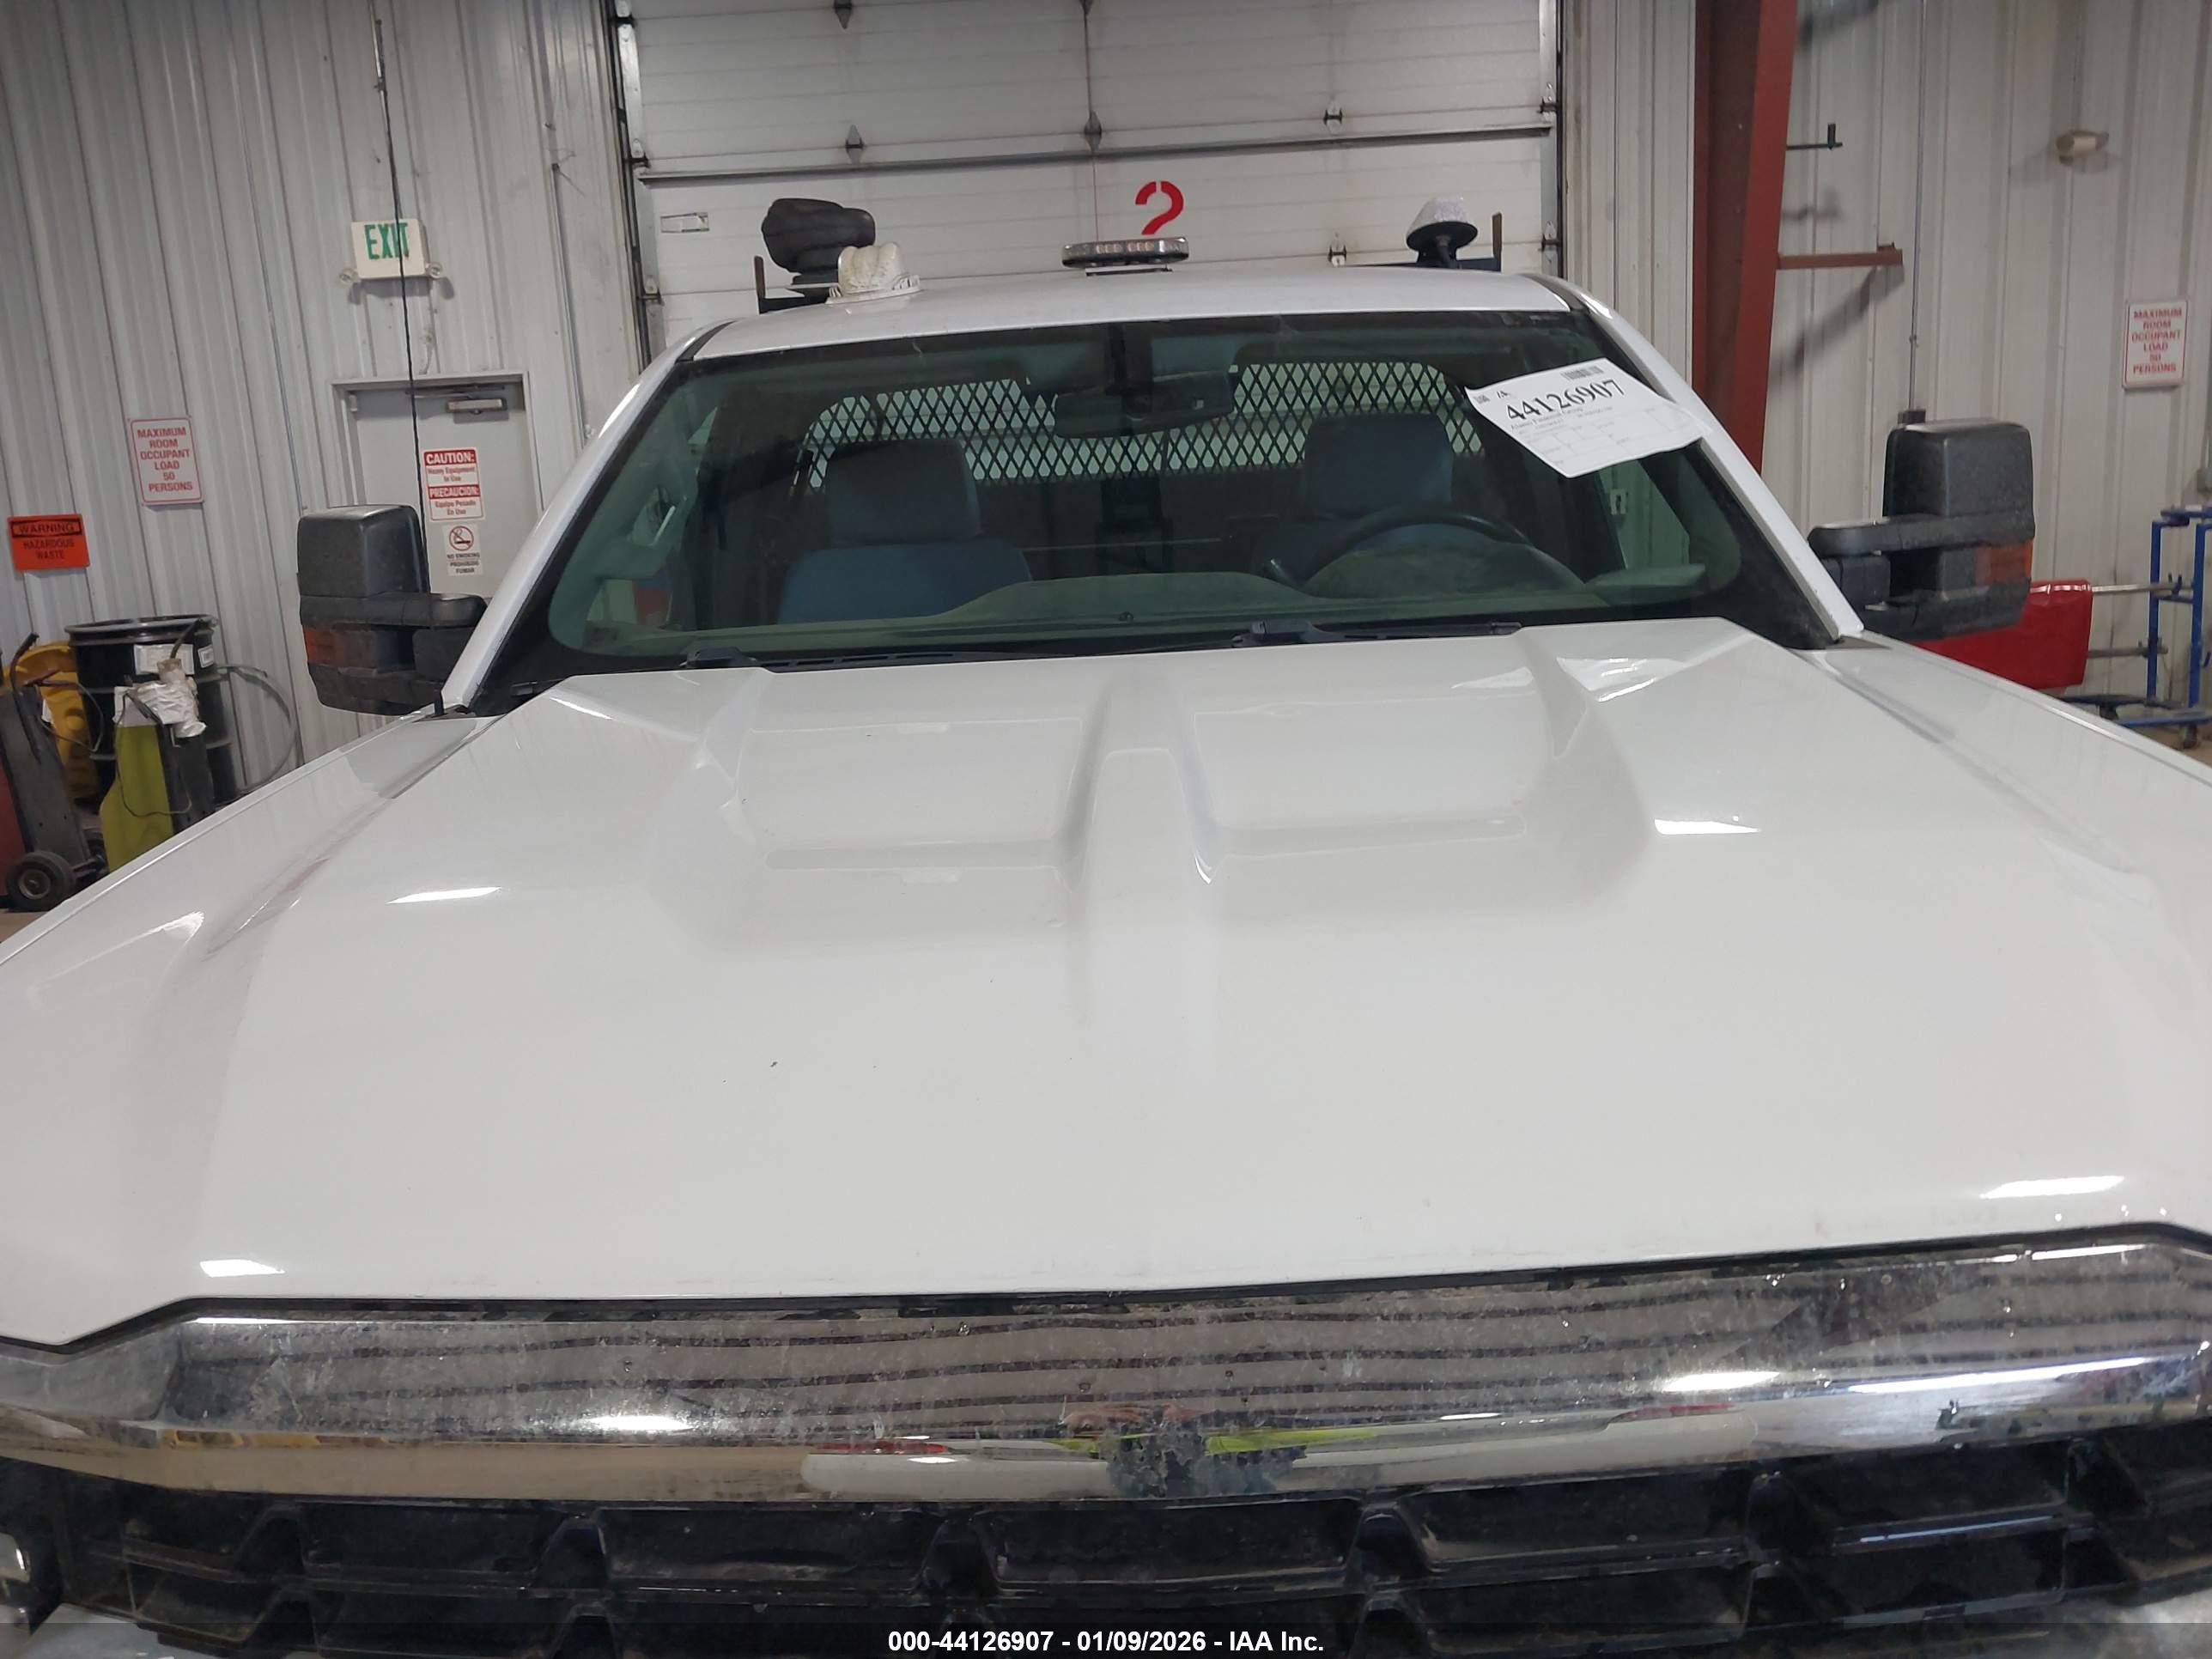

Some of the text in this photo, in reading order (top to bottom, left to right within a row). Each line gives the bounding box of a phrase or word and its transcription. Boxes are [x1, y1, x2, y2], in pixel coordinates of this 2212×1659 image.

[1135, 180, 1184, 235] 2
[364, 222, 409, 259] EXIT
[2134, 308, 2182, 319] MAXIMUM
[2143, 320, 2171, 330] ROOM
[2131, 330, 2180, 342] OCCUPANT
[2143, 343, 2168, 351] LOAD
[2133, 362, 2176, 374] PERSONS
[1507, 379, 1625, 420] 44126907
[137, 427, 186, 438] MAXIMUM
[149, 439, 179, 448] ROOM
[140, 449, 190, 460] OCCUPANT
[426, 453, 475, 465] CAUTION:
[154, 460, 179, 471] LOAD
[163, 472, 175, 481] 50
[149, 482, 193, 492] PERSONS
[19, 521, 75, 534] WARNING
[22, 538, 75, 550] HAZARDOUS
[35, 549, 65, 560] WASTE
